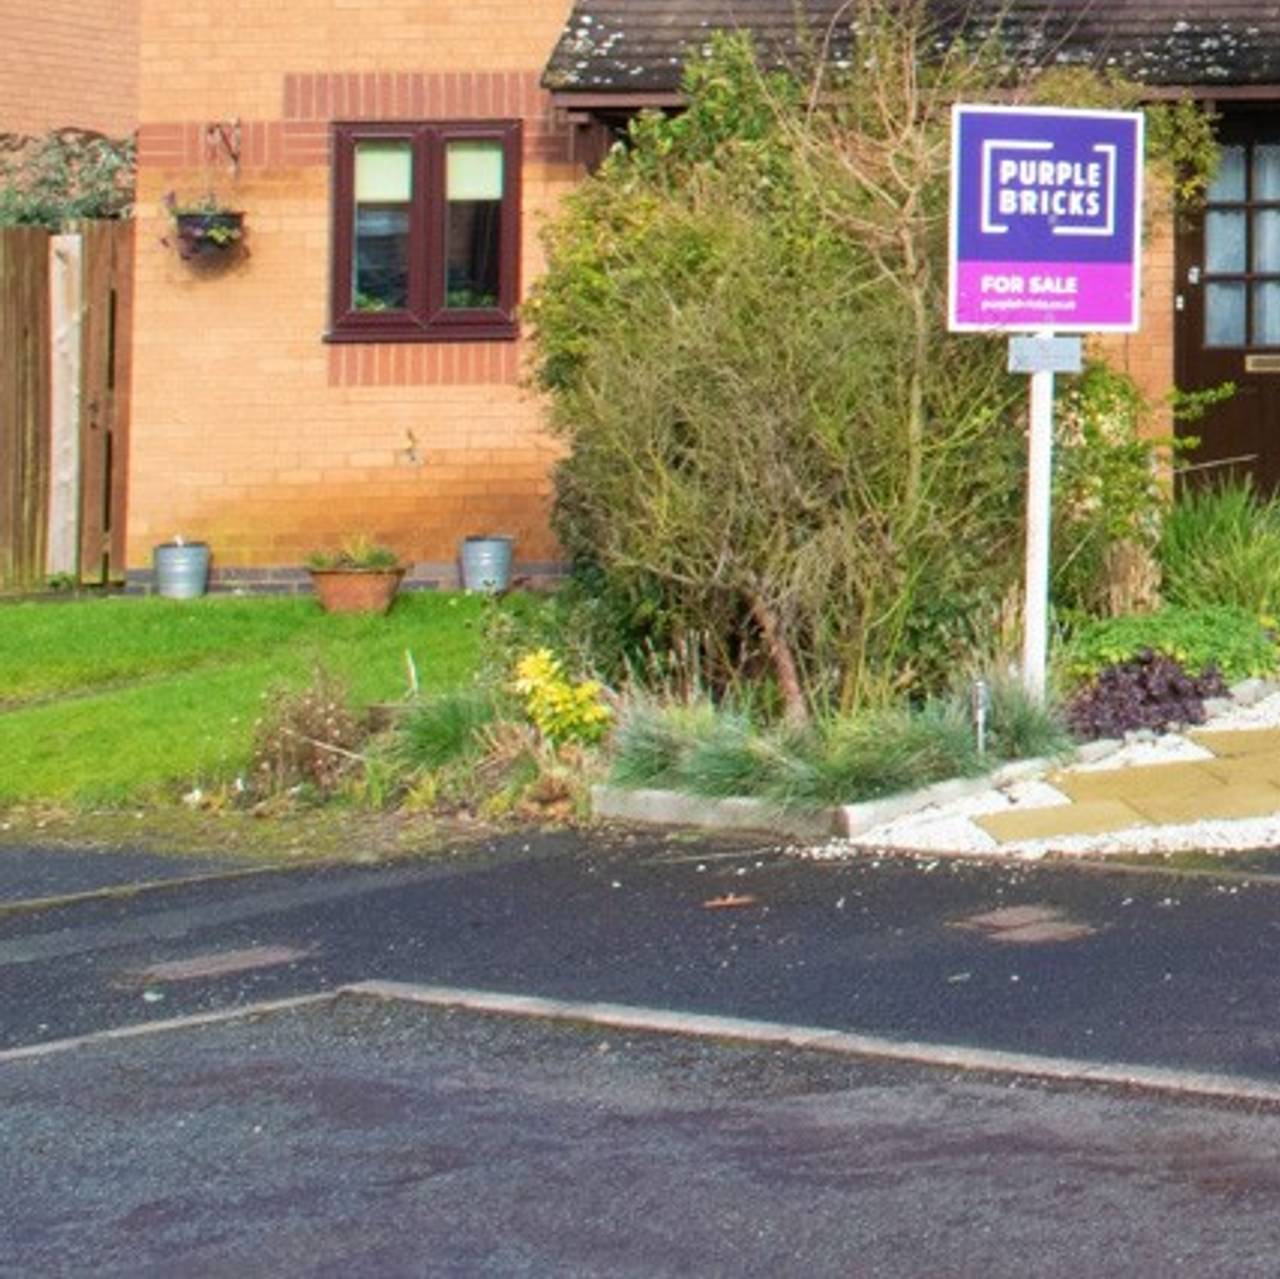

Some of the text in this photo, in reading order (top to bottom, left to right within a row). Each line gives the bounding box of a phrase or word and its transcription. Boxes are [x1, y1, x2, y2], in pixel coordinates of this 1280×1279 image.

[999, 159, 1100, 187] PURPLE
[999, 189, 1100, 216] BRICKS
[980, 274, 1078, 294] FOR SALE
